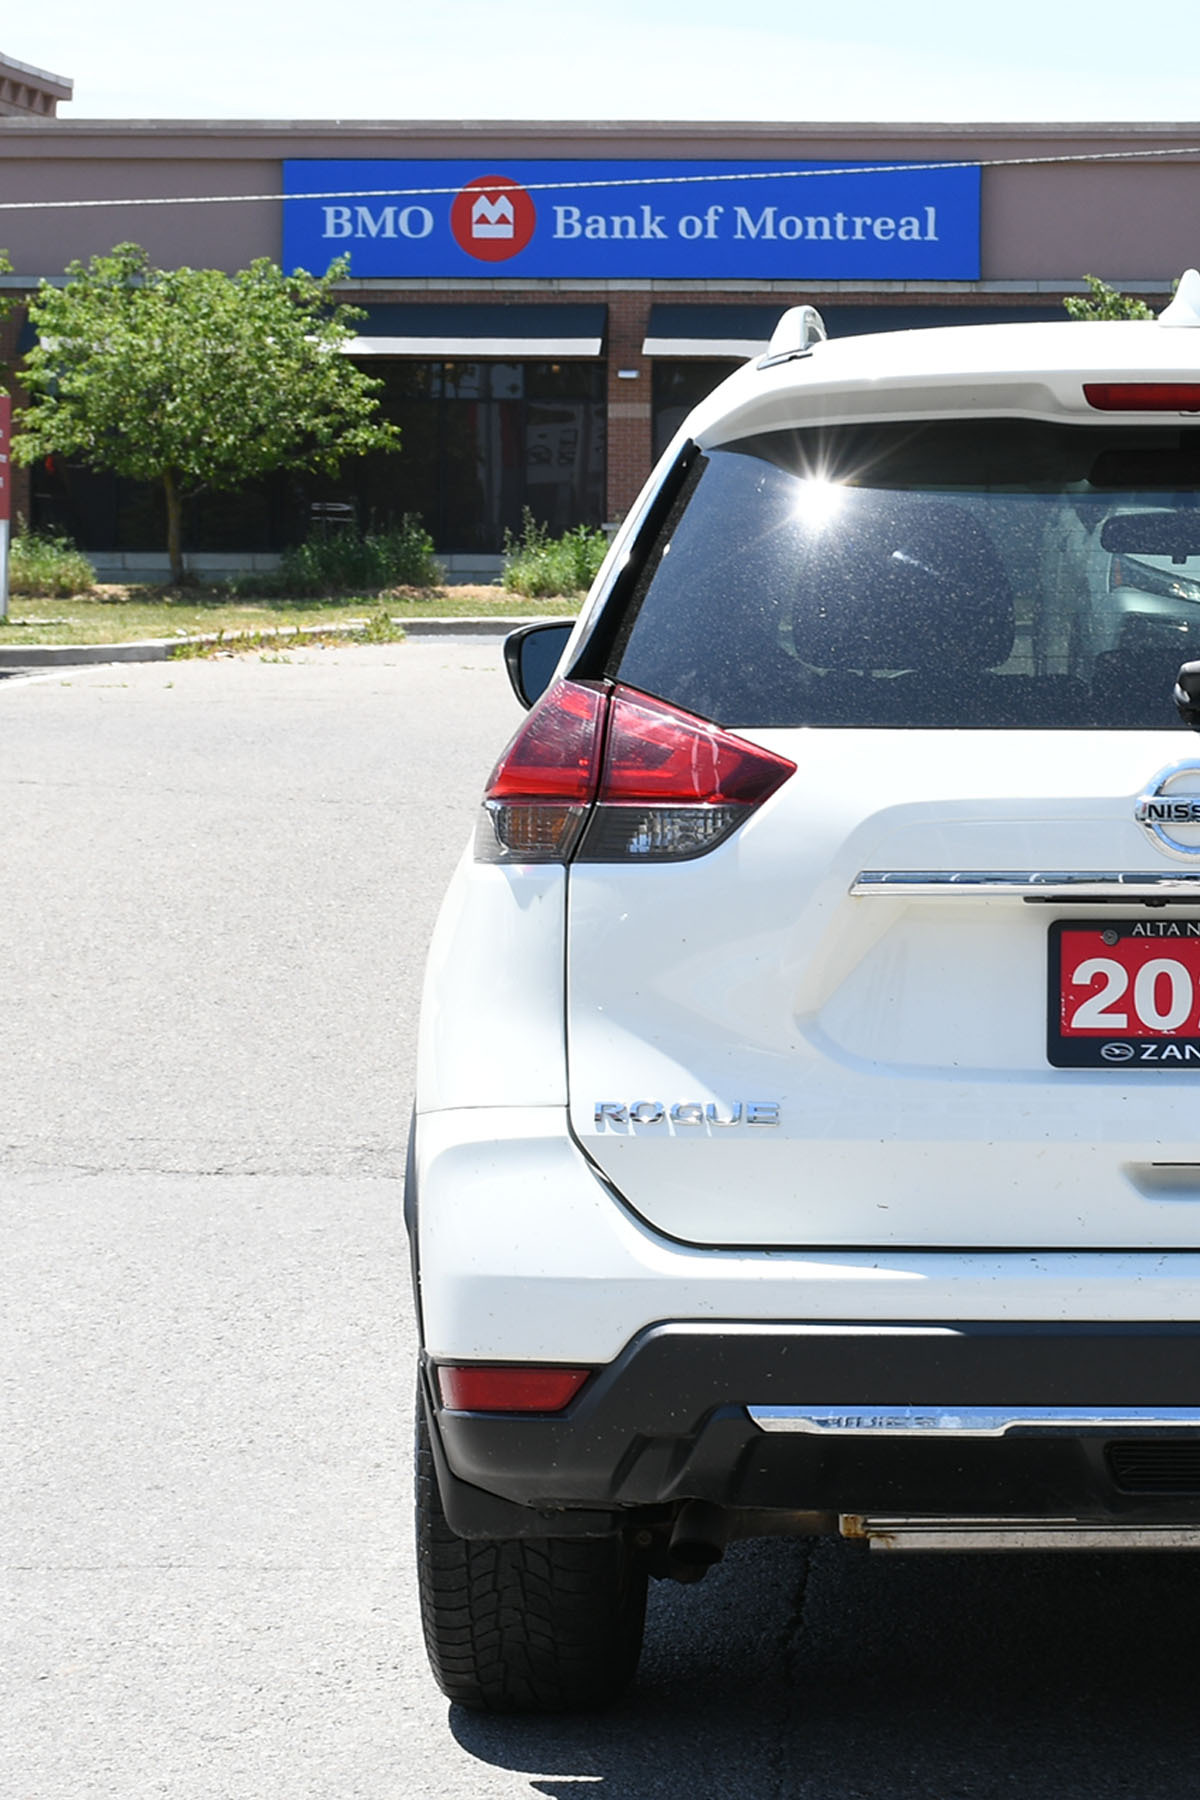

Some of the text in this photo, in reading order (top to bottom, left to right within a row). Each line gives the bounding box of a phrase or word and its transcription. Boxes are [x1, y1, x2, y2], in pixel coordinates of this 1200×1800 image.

[321, 205, 939, 241] BMO Bank of Montreal
[1132, 922, 1178, 937] ALTA
[594, 1100, 781, 1127] ROGUE
